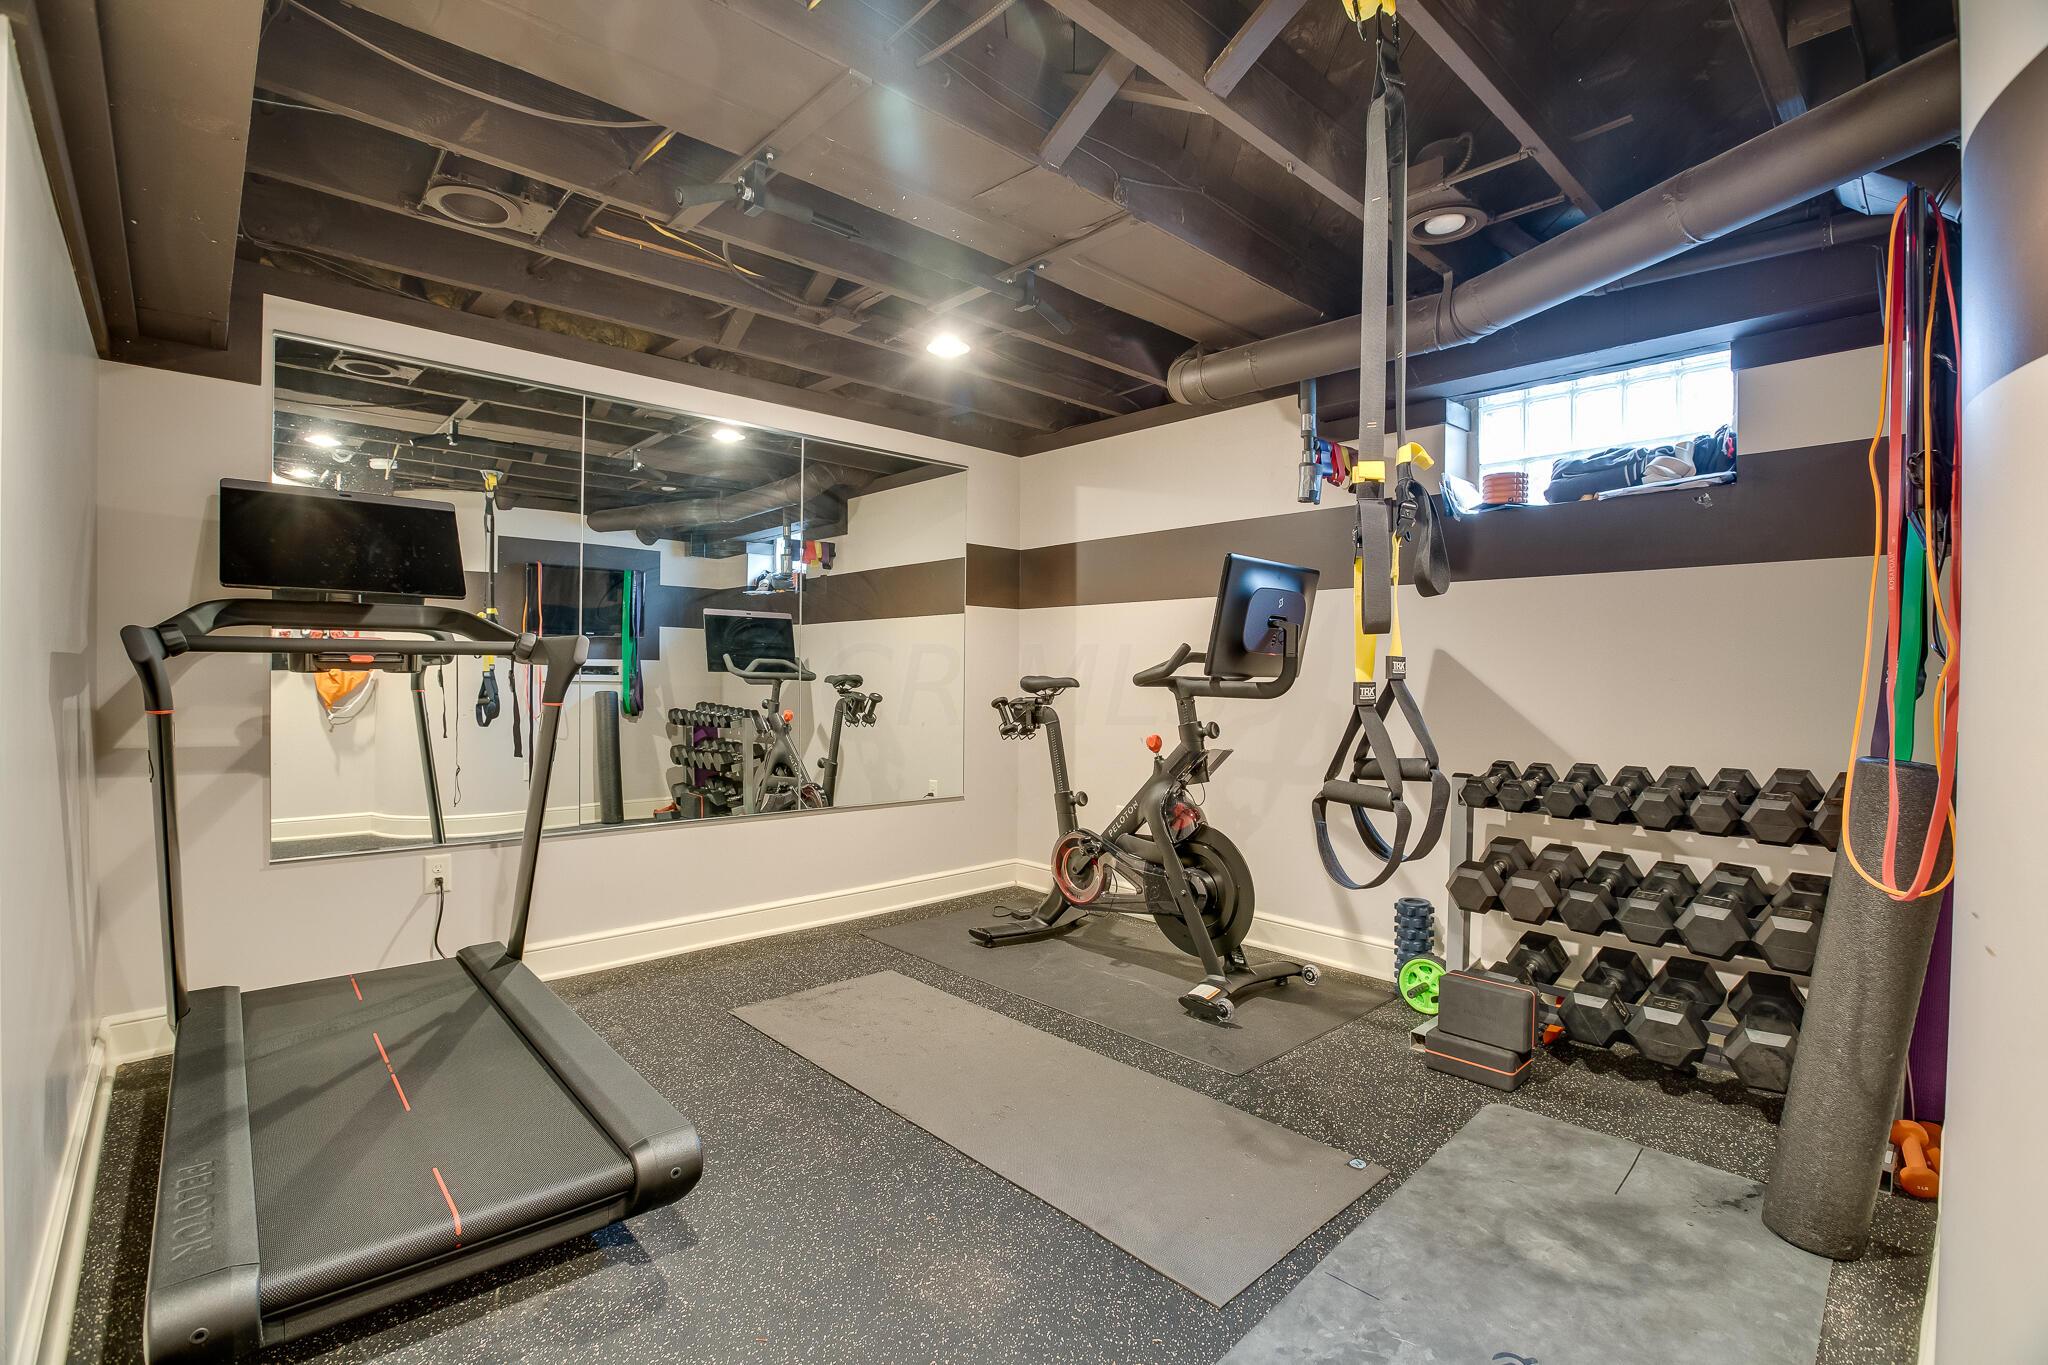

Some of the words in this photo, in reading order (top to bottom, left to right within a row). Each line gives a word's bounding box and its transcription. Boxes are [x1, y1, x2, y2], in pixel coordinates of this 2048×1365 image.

[1392, 661, 1406, 670] TRX
[1359, 686, 1376, 696] TRX
[1108, 800, 1139, 838] PELOTON
[172, 1160, 215, 1261] PELOTON
